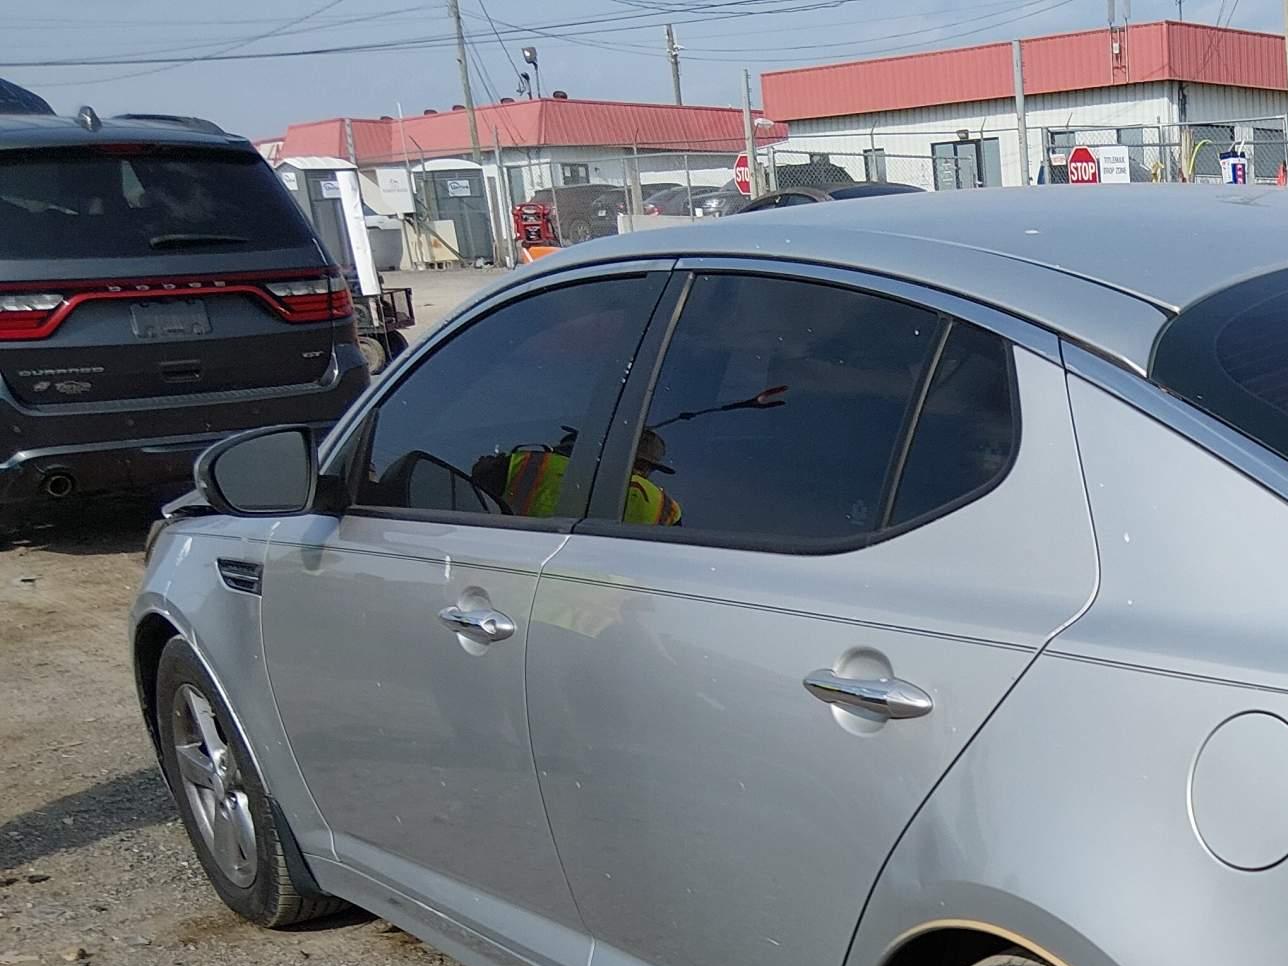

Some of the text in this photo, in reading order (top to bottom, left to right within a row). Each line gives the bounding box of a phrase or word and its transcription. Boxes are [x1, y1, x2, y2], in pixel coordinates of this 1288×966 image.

[736, 167, 750, 183] STO
[1070, 162, 1096, 181] STOP
[107, 280, 226, 293] DODGE
